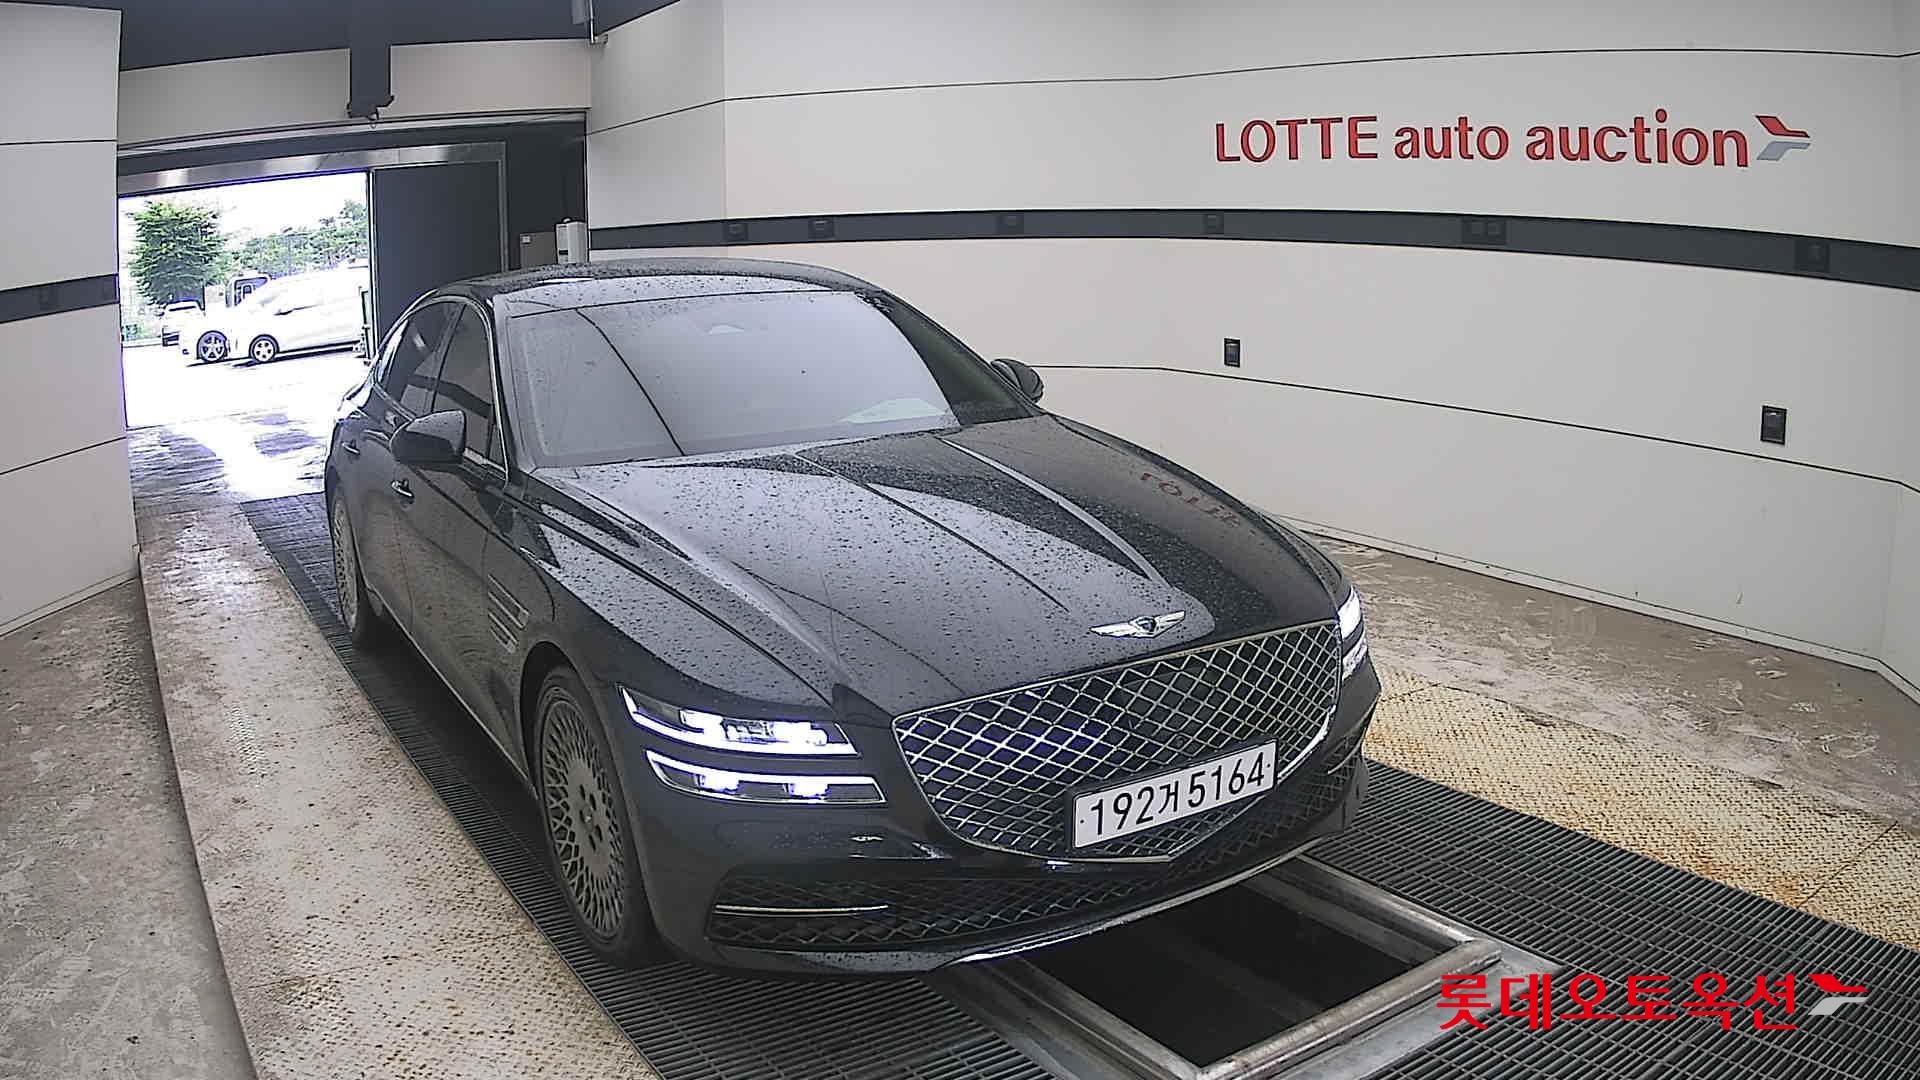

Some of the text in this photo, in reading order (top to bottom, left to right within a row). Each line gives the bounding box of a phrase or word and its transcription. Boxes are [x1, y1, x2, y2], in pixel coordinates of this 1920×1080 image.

[1215, 108, 1750, 167] LOTTE auto auction
